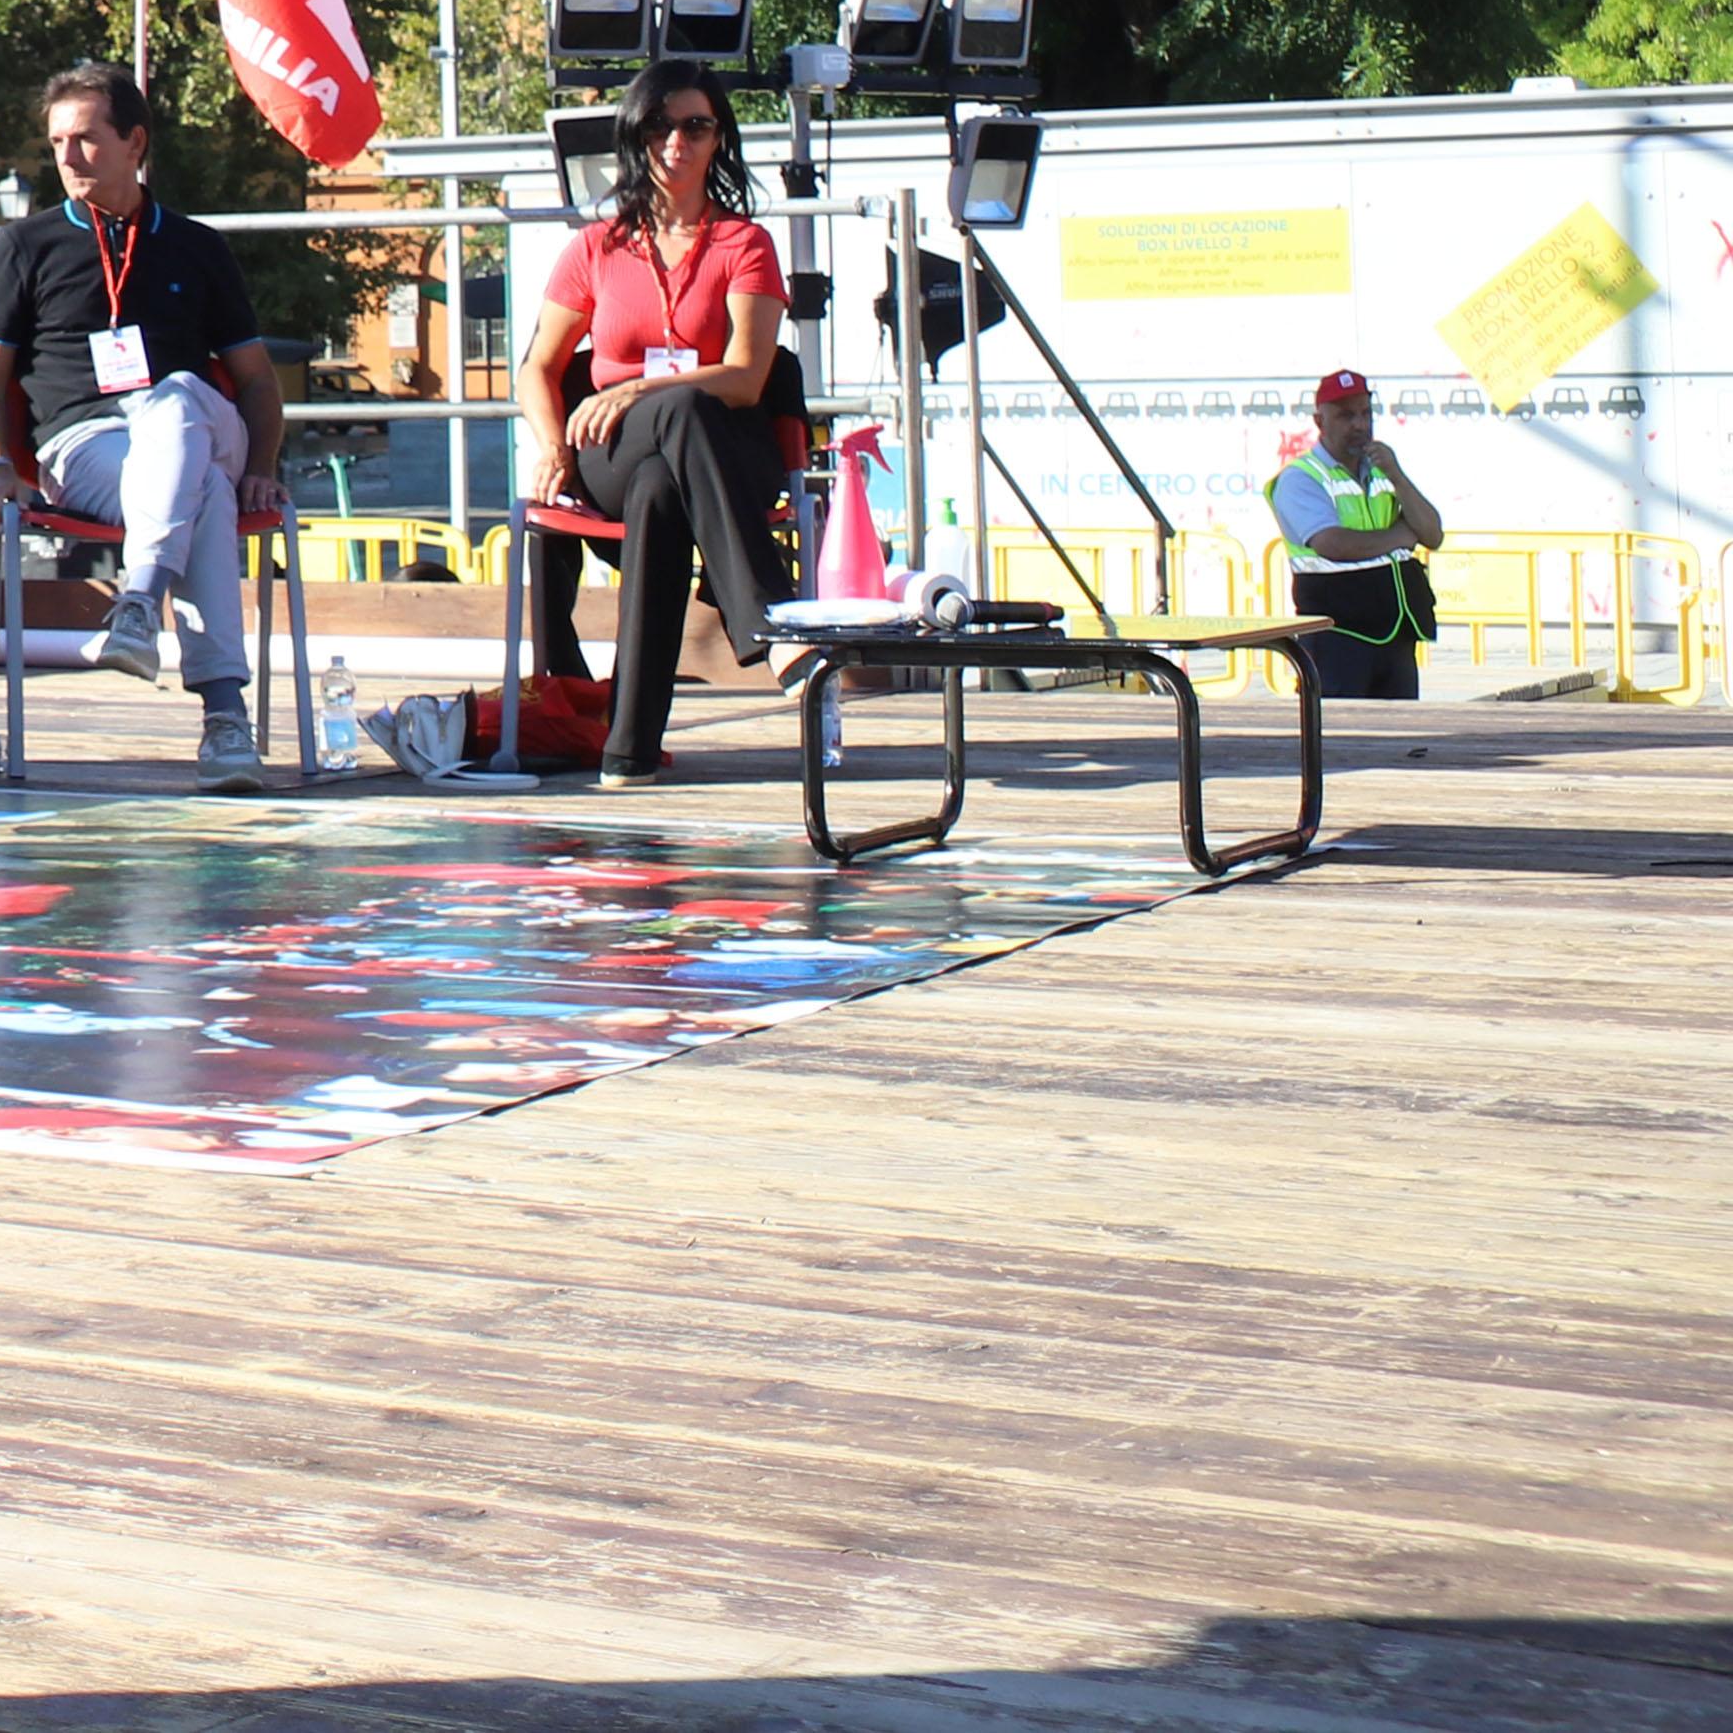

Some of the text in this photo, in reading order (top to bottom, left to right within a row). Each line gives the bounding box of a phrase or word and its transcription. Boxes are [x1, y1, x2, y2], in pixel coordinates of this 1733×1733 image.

[1098, 219, 1288, 238] SOLUZIONI DI LOCAZIONE
[1137, 239, 1169, 252] BOX
[1174, 237, 1232, 251] LIVELLO
[1463, 226, 1581, 326] PROMOZIONE
[1471, 311, 1513, 347] BOX
[1512, 257, 1579, 317] LIVELLO
[1040, 473, 1069, 495] IN
[1078, 472, 1195, 496] CENTRO
